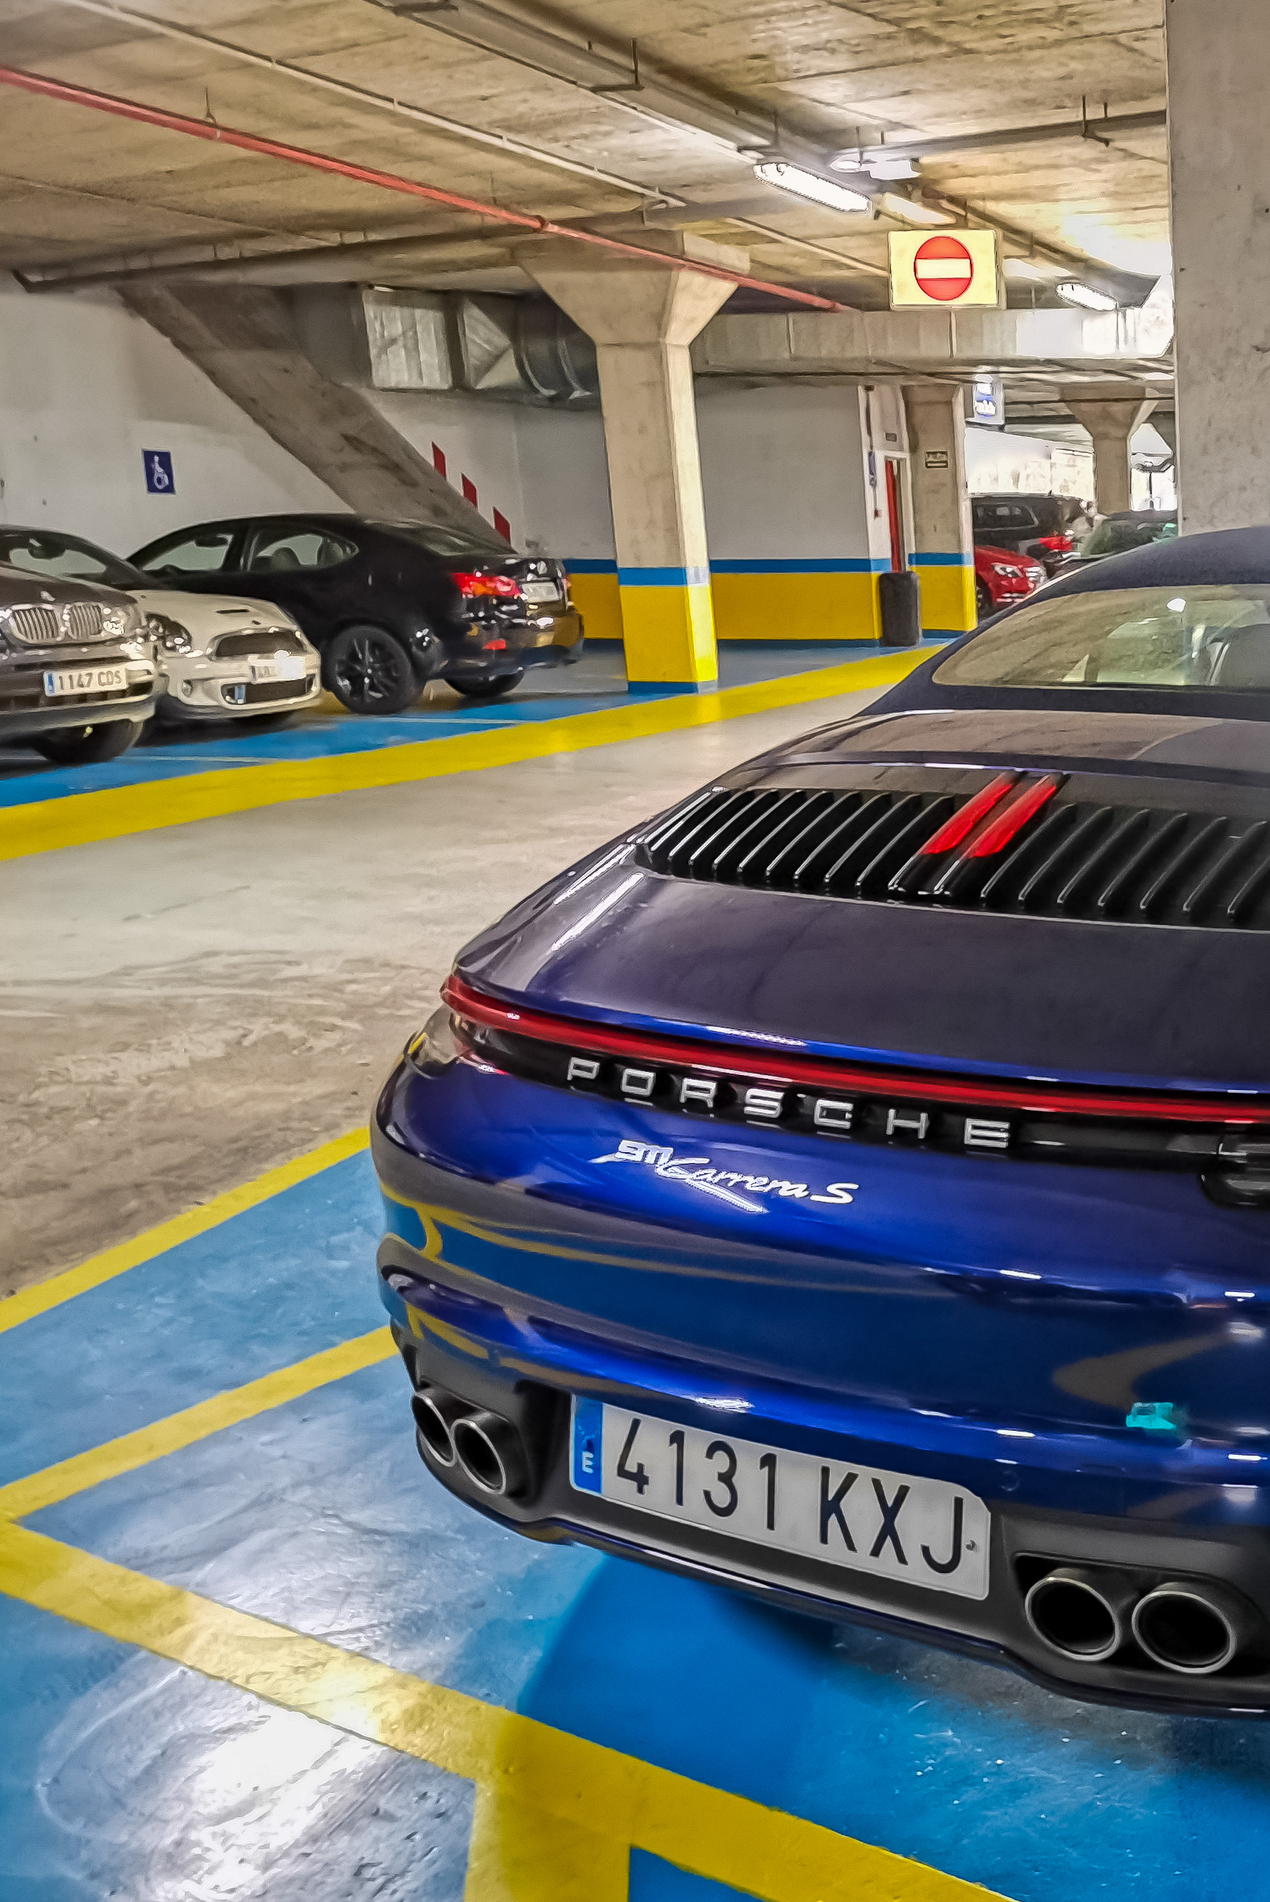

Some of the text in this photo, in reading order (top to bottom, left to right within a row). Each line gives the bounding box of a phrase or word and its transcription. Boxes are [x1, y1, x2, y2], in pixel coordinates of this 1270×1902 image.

[58, 672, 93, 691] 1147
[565, 1056, 1011, 1148] PORSCHE
[594, 1139, 860, 1205] 911 Carrera S
[581, 1450, 594, 1474] E
[616, 1418, 964, 1574] 4131 KXJ
